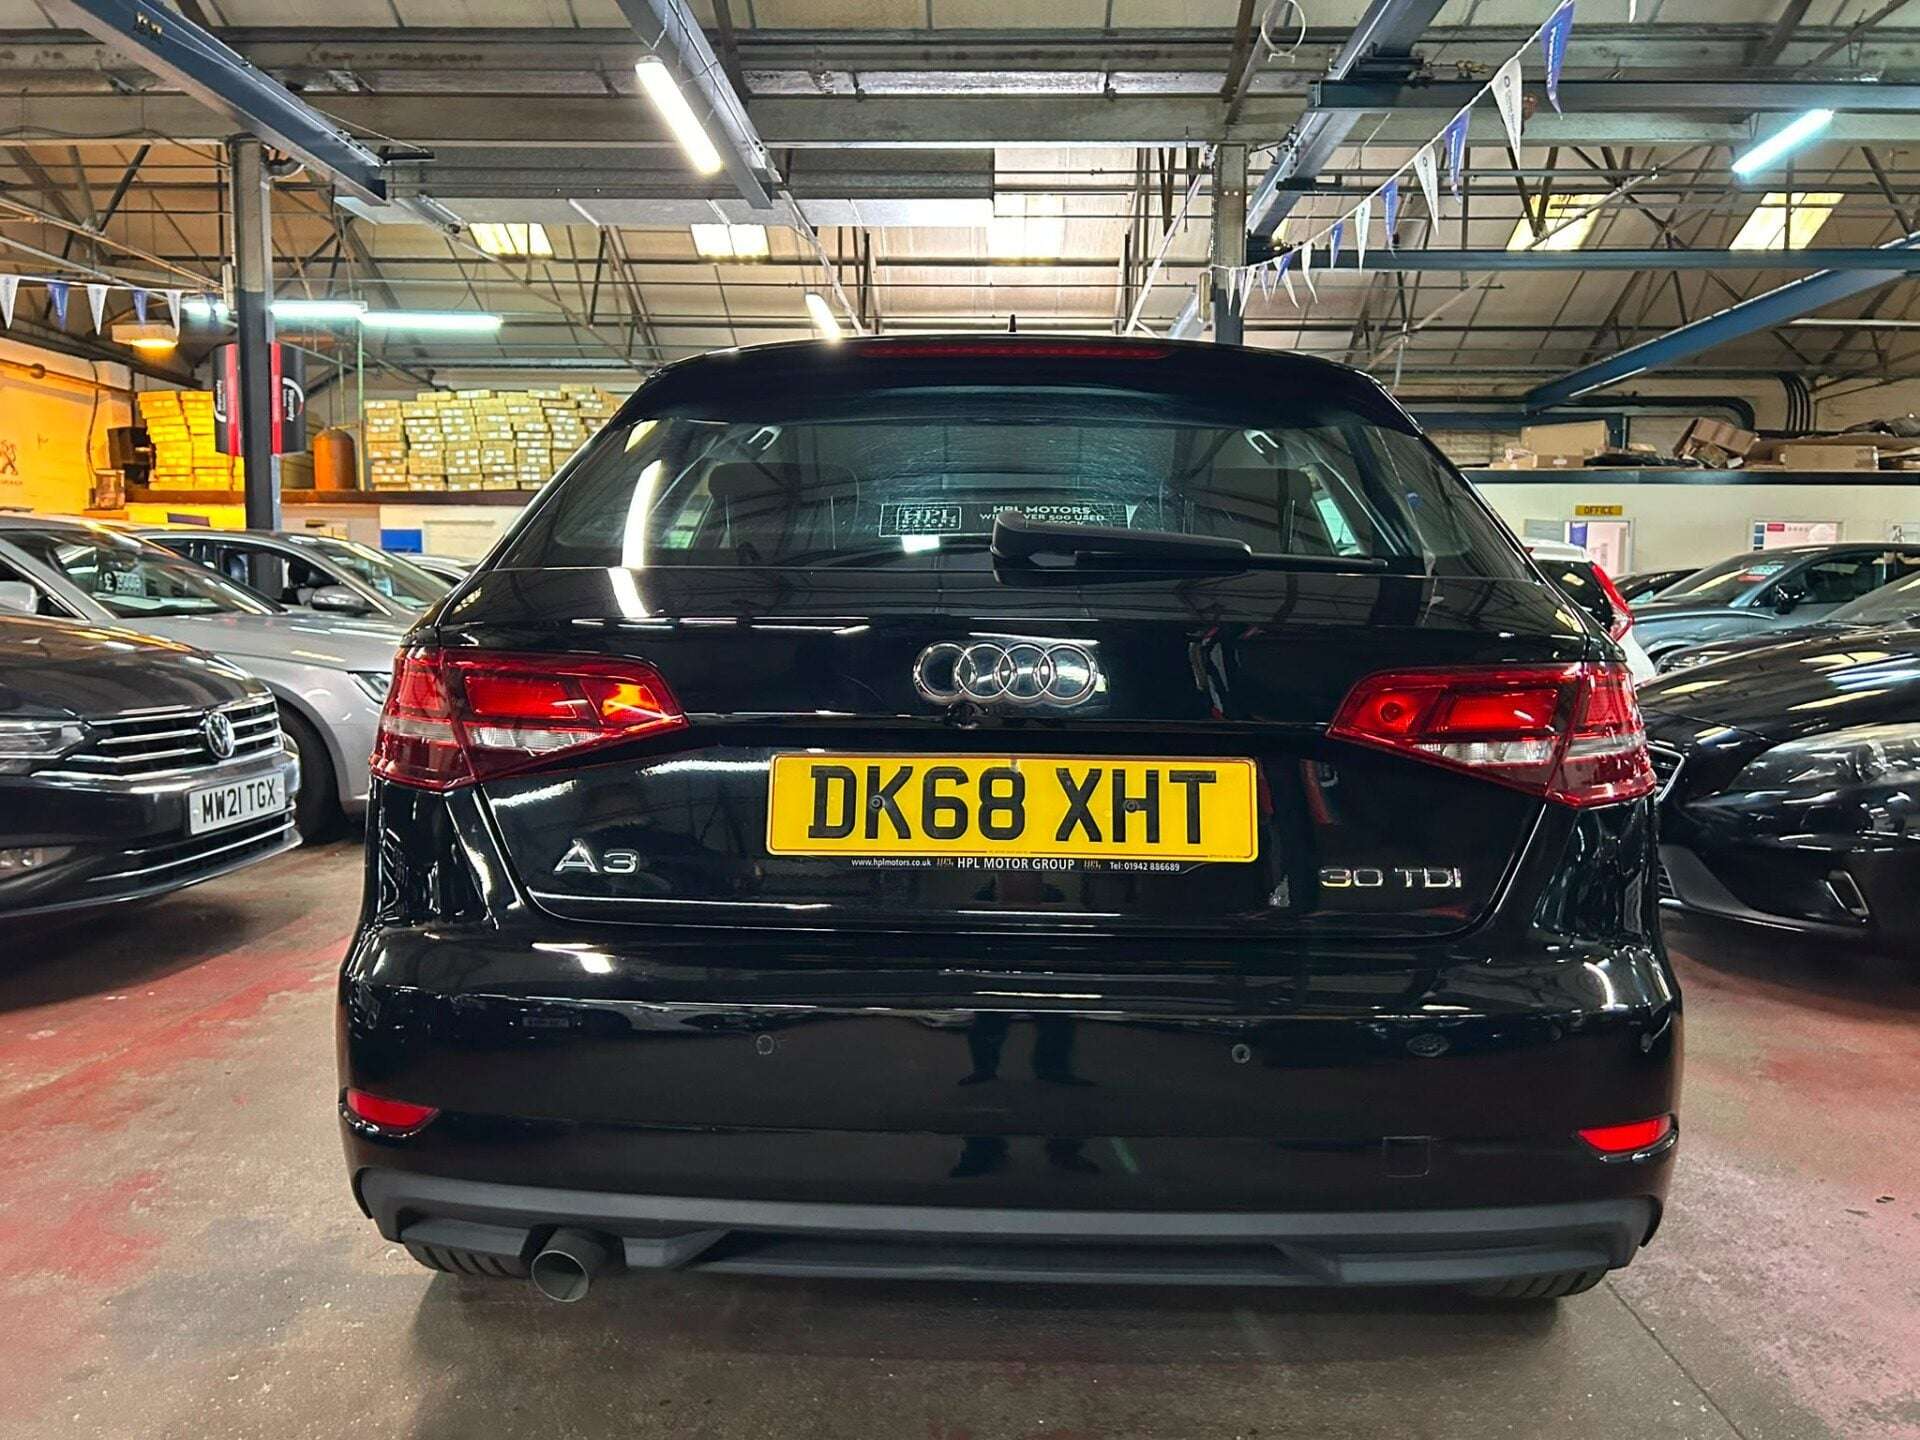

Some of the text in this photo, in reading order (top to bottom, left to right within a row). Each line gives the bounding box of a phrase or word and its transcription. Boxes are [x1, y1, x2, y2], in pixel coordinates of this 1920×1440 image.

[1026, 505, 1091, 514] MOTORS
[1074, 513, 1105, 521] USED
[202, 778, 276, 824] MW21 TGX
[807, 765, 1217, 844] DK68 XHT
[553, 839, 639, 874] A3
[851, 857, 932, 868] www.hplmotors.co.uk
[957, 857, 980, 869] HPL
[983, 857, 1029, 870] MOTOR
[1032, 858, 1075, 870] GROUP
[1320, 867, 1462, 889] 30 TDI
